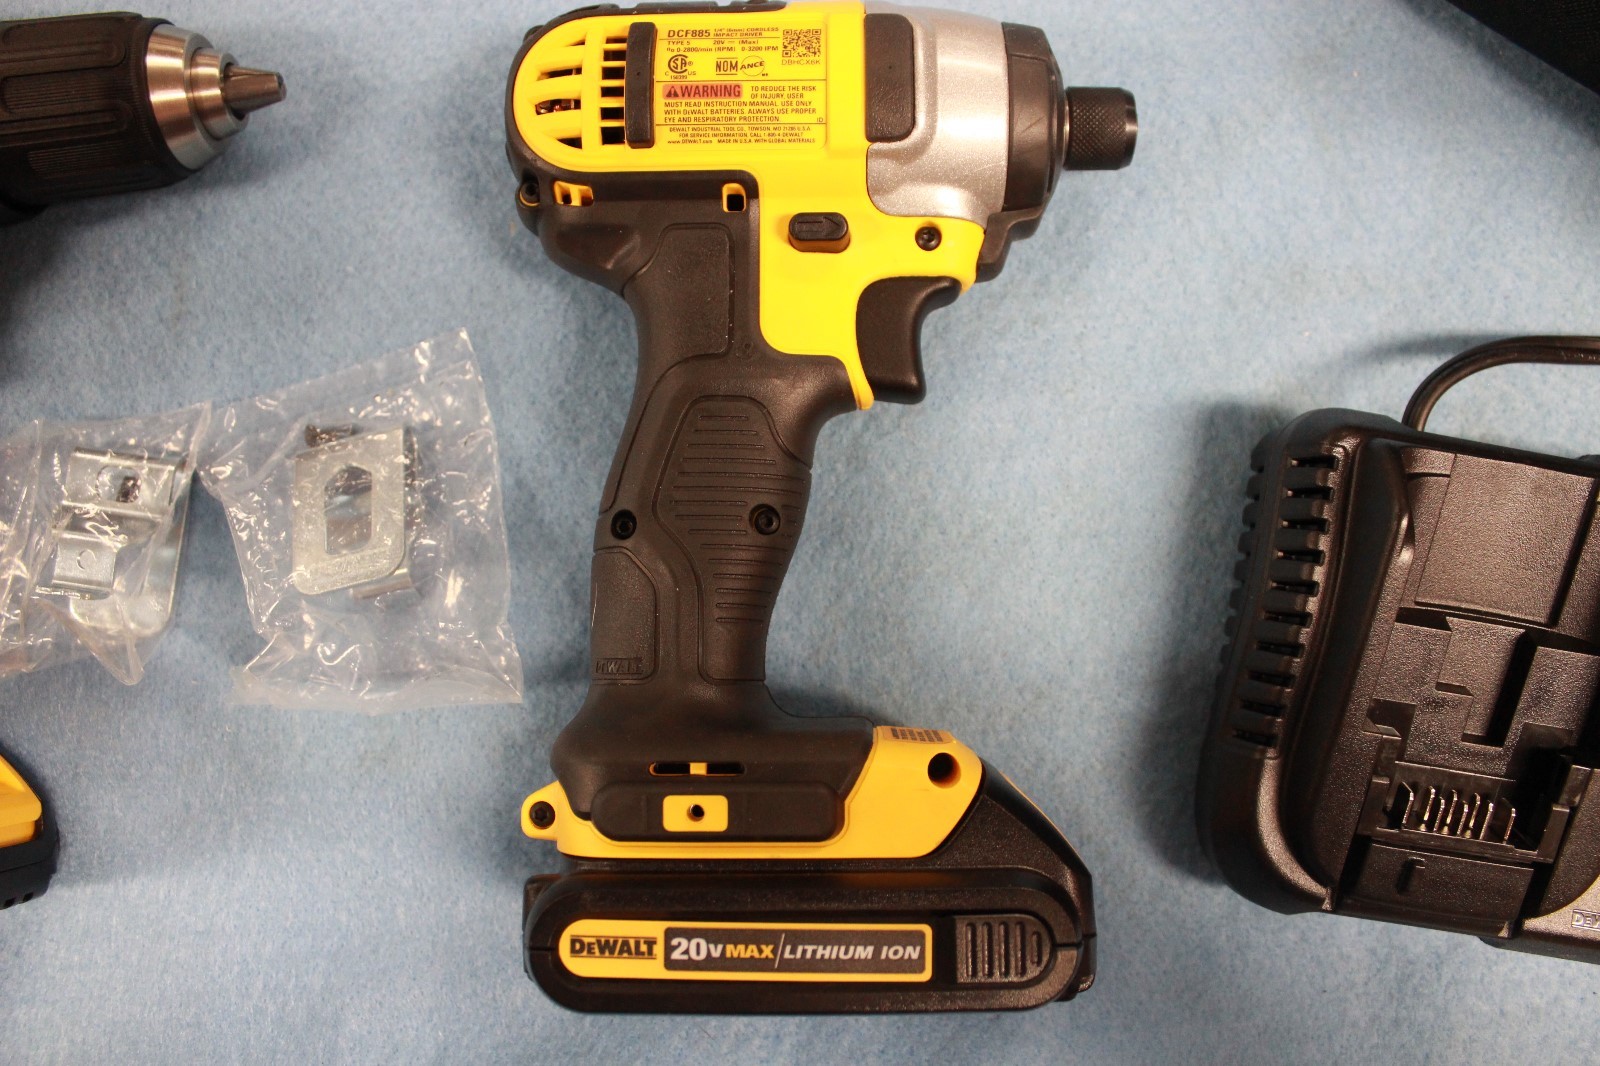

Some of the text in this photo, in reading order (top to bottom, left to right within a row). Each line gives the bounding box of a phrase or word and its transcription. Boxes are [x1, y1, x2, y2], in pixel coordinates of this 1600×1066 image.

[667, 29, 711, 38] DCF885
[716, 60, 738, 72] NOM
[740, 60, 765, 70] ANCE
[680, 85, 741, 98] WARNING
[783, 944, 872, 961] LITHIUM
[880, 945, 920, 961] ION
